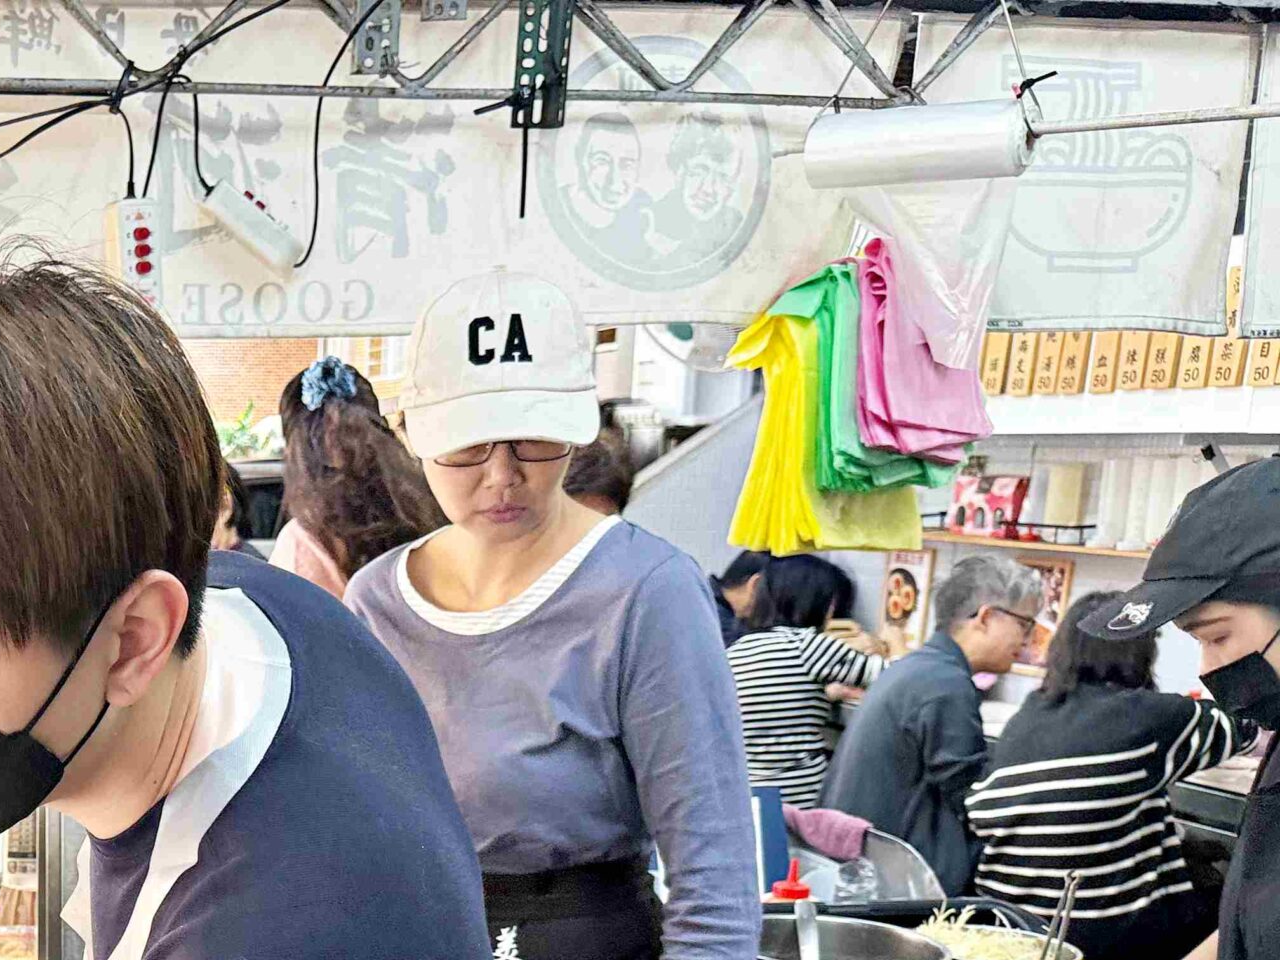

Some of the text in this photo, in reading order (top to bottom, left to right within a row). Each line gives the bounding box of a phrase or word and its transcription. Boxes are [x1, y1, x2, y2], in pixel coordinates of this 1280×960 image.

[467, 313, 533, 365] CA
[1122, 370, 1138, 385] 50
[1151, 369, 1166, 383] 50
[1184, 367, 1200, 383] 50
[1216, 367, 1232, 381] 50
[1254, 365, 1270, 381] 50
[1093, 374, 1107, 388] 50
